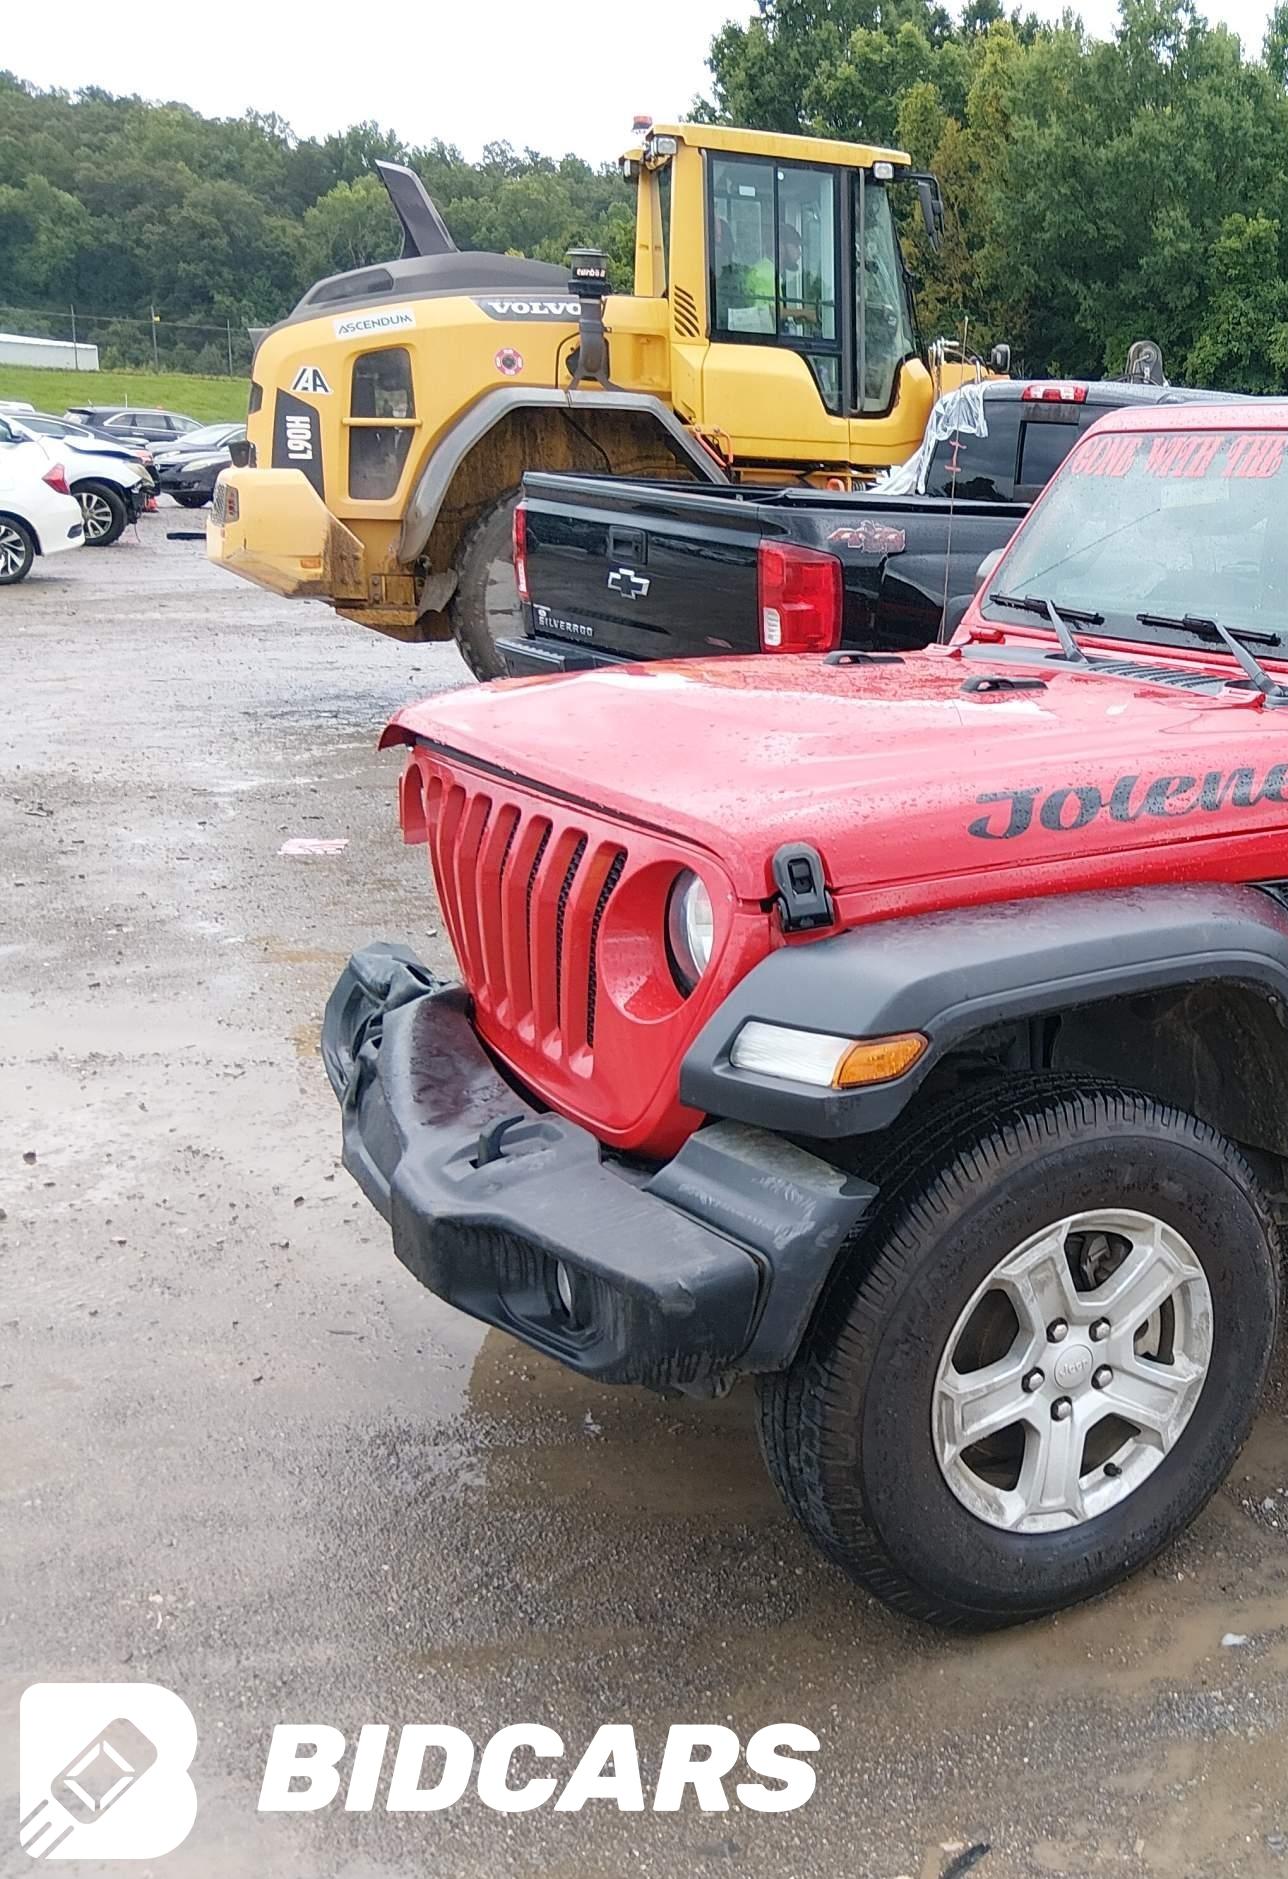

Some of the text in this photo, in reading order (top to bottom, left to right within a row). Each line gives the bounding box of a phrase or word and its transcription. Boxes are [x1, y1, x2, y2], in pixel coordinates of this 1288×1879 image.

[487, 302, 581, 315] VOLVO
[338, 314, 413, 335] ASCENDUM
[285, 415, 313, 460] L90H
[1071, 436, 1143, 478] GONE
[1144, 435, 1225, 478] WITH
[538, 615, 593, 637] SILVERADO
